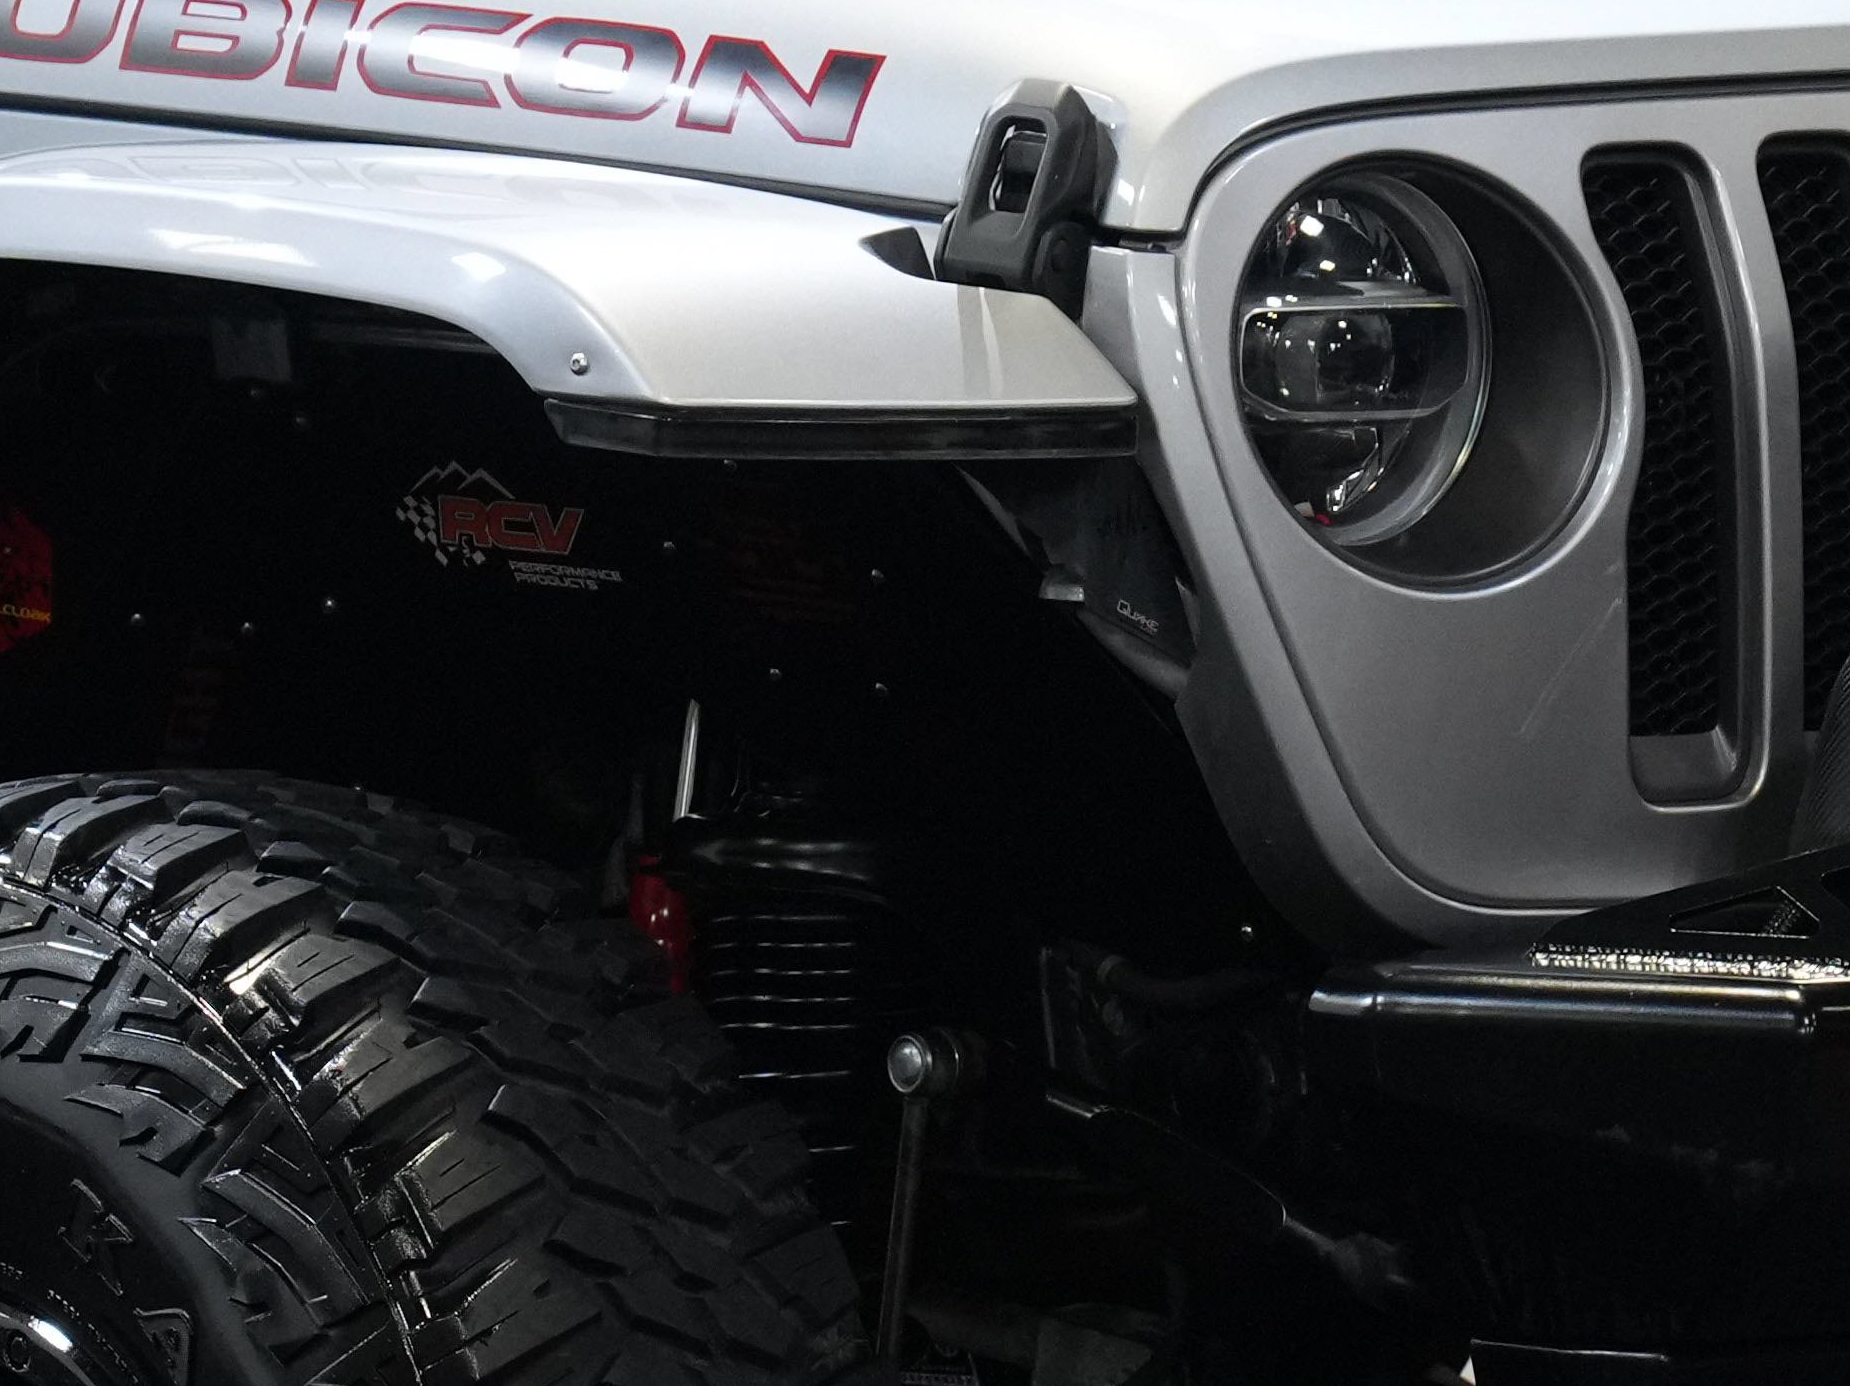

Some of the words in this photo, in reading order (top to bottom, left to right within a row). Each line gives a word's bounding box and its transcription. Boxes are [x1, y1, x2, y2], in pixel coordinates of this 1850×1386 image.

[438, 494, 584, 555] RCV
[509, 560, 623, 583] PERFORMANCE
[514, 572, 598, 591] PRODUCTS
